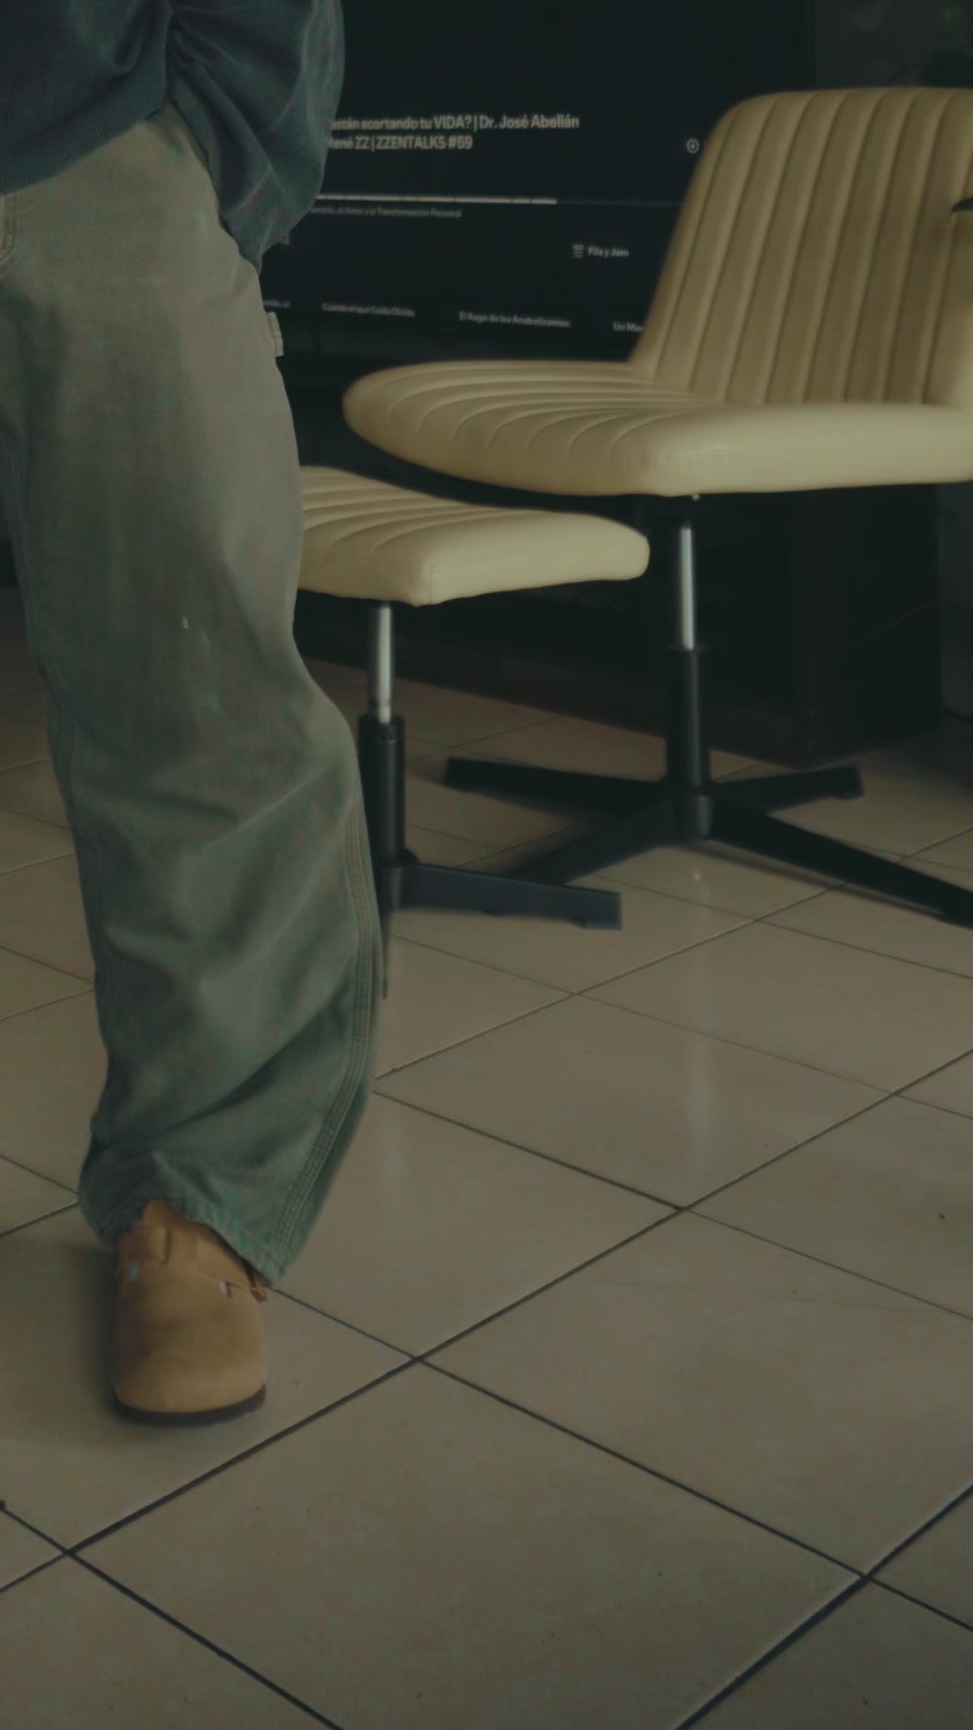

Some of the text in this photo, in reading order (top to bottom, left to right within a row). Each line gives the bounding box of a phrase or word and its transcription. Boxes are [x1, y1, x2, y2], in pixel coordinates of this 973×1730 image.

[419, 116, 432, 130] tu
[433, 114, 472, 130] VIDA?
[479, 114, 498, 130] Dr.
[499, 114, 529, 130] José
[531, 114, 580, 130] Abellán
[355, 135, 370, 150] ZZ
[376, 134, 446, 150] ZZENTALKS
